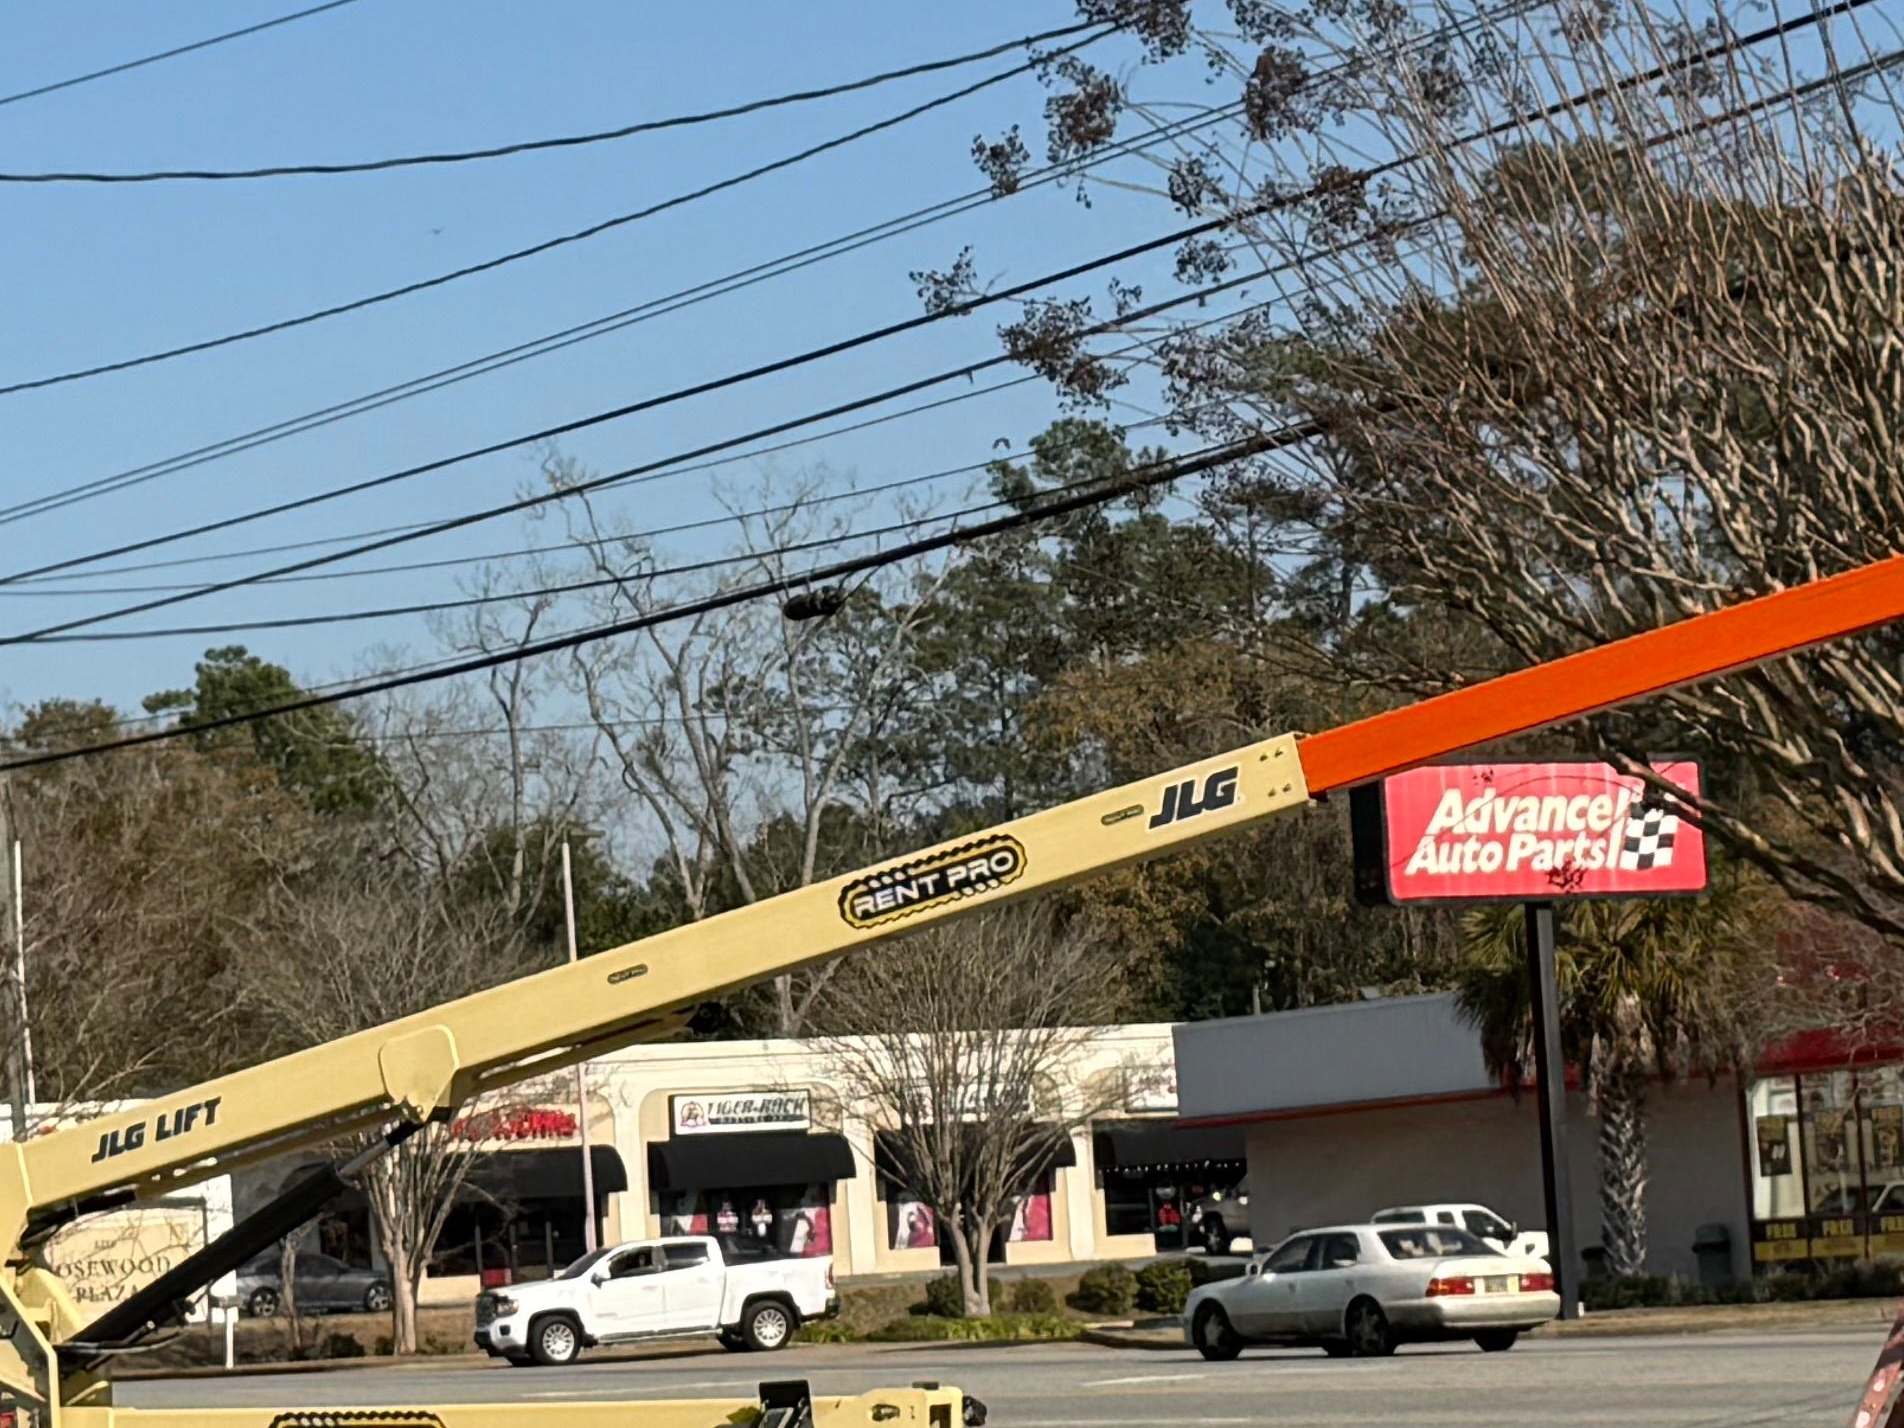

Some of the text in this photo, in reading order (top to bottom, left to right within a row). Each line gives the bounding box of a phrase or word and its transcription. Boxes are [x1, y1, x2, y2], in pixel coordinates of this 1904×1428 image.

[1149, 766, 1239, 830] JLG
[1425, 787, 1614, 835] Advance
[1404, 830, 1606, 876] Auto Parts
[853, 850, 1015, 918] RENT PRO
[91, 1096, 222, 1164] JLG LIFT
[57, 1255, 171, 1278] OSEWOOD
